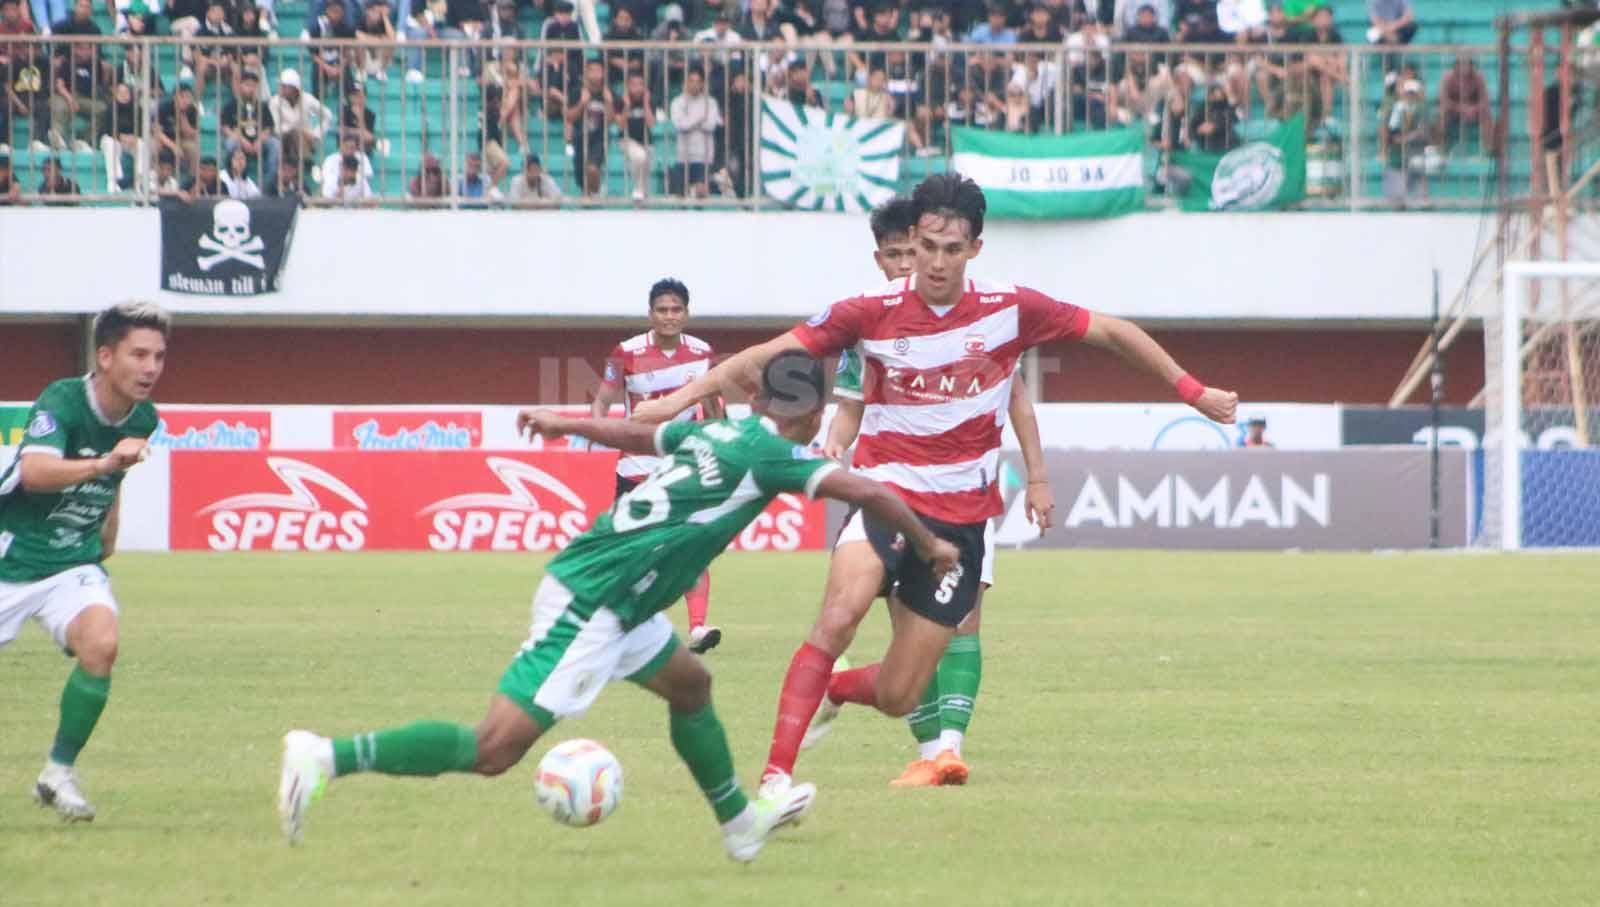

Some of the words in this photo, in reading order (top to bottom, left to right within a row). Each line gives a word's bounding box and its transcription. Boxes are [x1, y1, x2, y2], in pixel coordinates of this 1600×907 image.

[1065, 472, 1331, 528] AMMAN
[208, 510, 369, 550] SPECS
[428, 510, 588, 550] SPECS
